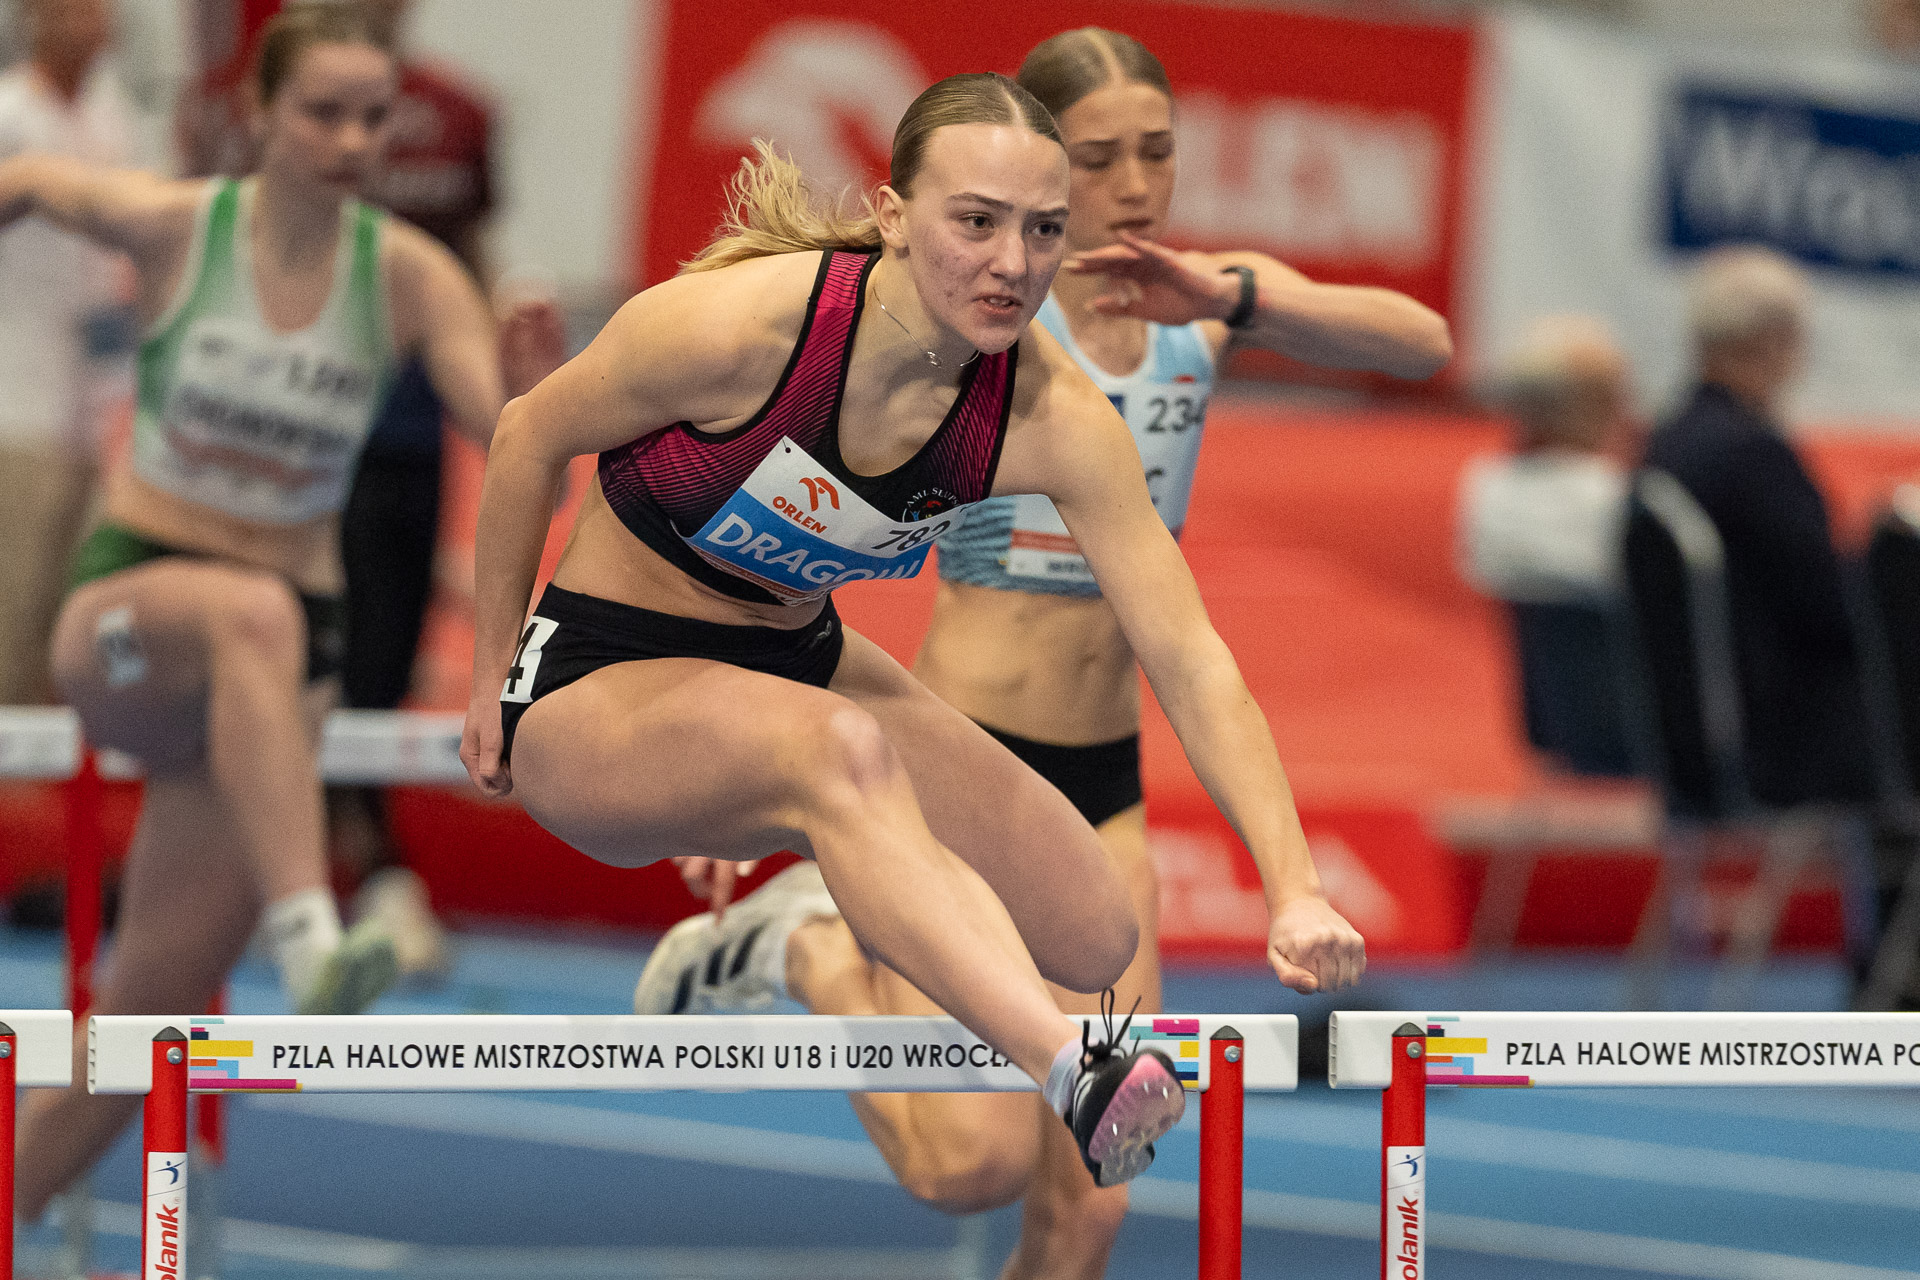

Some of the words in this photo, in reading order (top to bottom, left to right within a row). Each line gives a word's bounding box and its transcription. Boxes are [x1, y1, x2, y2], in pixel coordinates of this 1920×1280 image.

[772, 495, 828, 534] ORLEN
[871, 520, 951, 552] 782
[507, 622, 539, 695] 4
[273, 1045, 335, 1069] PZLA
[347, 1043, 465, 1069] HALOWE
[474, 1044, 665, 1069] MISTRZOSTWA
[675, 1044, 764, 1069] POLSKI
[775, 1045, 822, 1069] U18
[831, 1044, 837, 1069] i
[846, 1044, 893, 1069] U20
[1506, 1042, 1565, 1066] PZLA
[1578, 1041, 1690, 1066] HALOWE
[1700, 1042, 1884, 1066] MISTRZOSTWA
